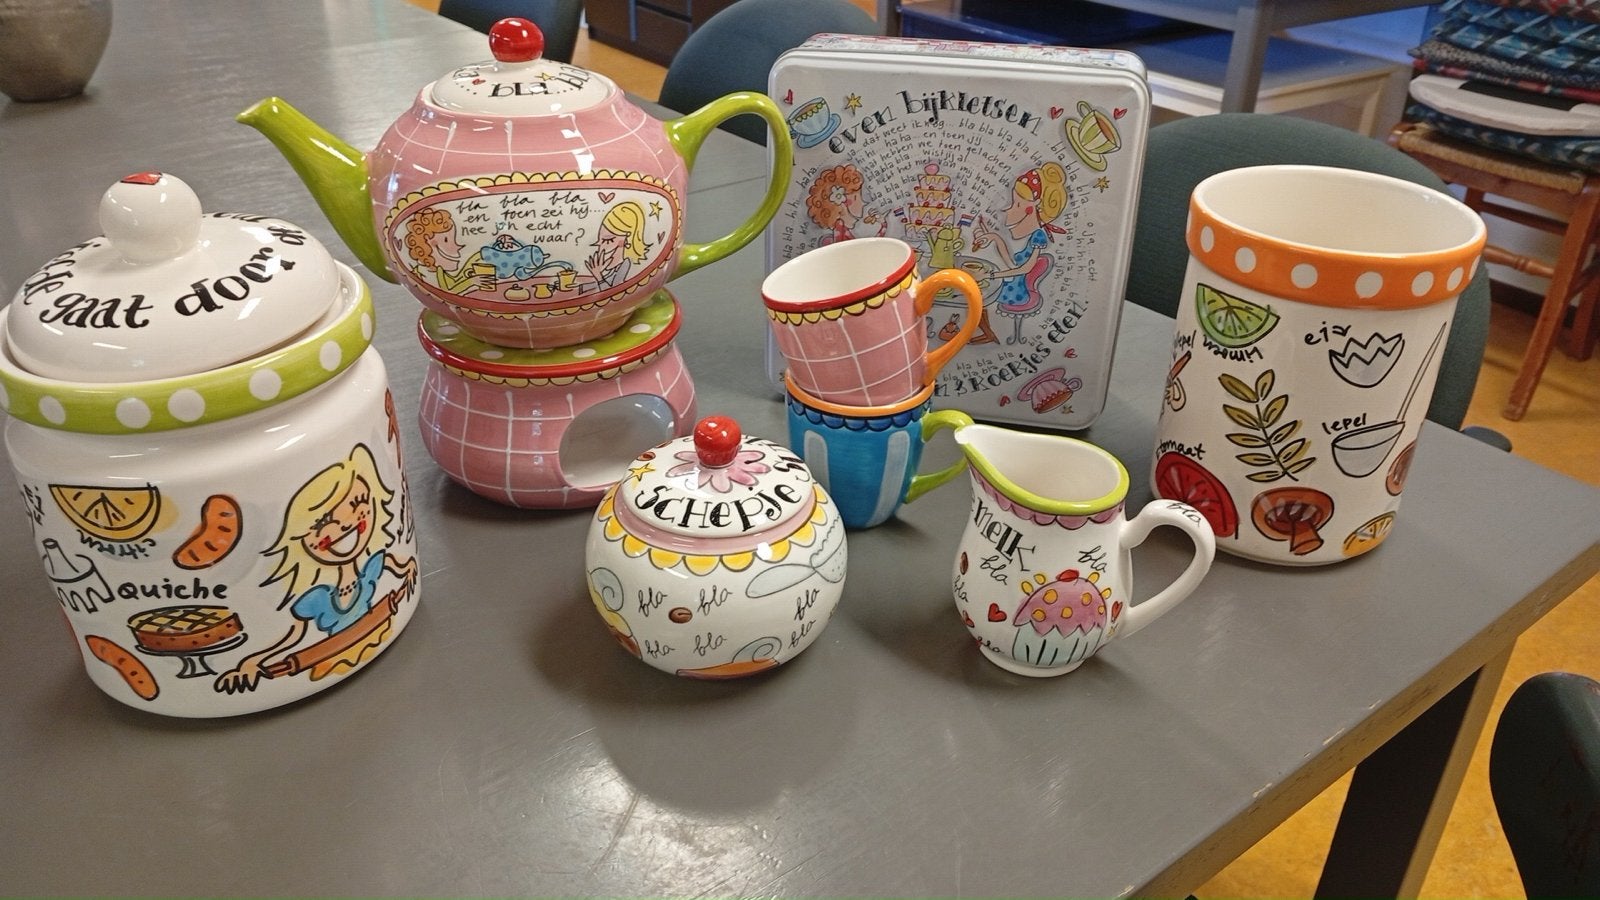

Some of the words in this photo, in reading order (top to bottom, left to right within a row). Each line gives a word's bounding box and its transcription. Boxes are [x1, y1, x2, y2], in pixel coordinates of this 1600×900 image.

[829, 106, 897, 154] even
[896, 89, 1042, 137] bijkletsen
[942, 131, 965, 140] toen
[862, 133, 880, 148] dat
[883, 123, 907, 138] weet
[959, 118, 976, 130] bla
[979, 122, 994, 136] bla
[997, 128, 1013, 142] bla
[1016, 139, 1029, 154] bla
[1030, 151, 1042, 166] bla
[880, 142, 913, 161] hebben
[966, 146, 1012, 172] gelachen
[1050, 141, 1066, 161] bla
[1065, 160, 1080, 182] bla
[1076, 184, 1090, 204] bla
[457, 200, 487, 215] bla
[500, 195, 535, 207] bla
[549, 191, 587, 205] bla
[464, 214, 491, 224] en
[501, 209, 536, 221] toen
[462, 225, 487, 236] nee
[527, 221, 563, 231] echt
[39, 293, 153, 329] gaat
[175, 247, 295, 316] door
[998, 351, 1015, 361] bla
[1321, 412, 1368, 435] lepel
[980, 555, 1008, 585] bla
[1079, 545, 1108, 573] bla
[118, 577, 228, 599] Quiche
[637, 587, 668, 616] bla
[697, 585, 733, 615] bla
[795, 588, 820, 621] bla
[693, 632, 727, 656] bla
[789, 619, 817, 648] bla
[647, 640, 675, 657] bla
